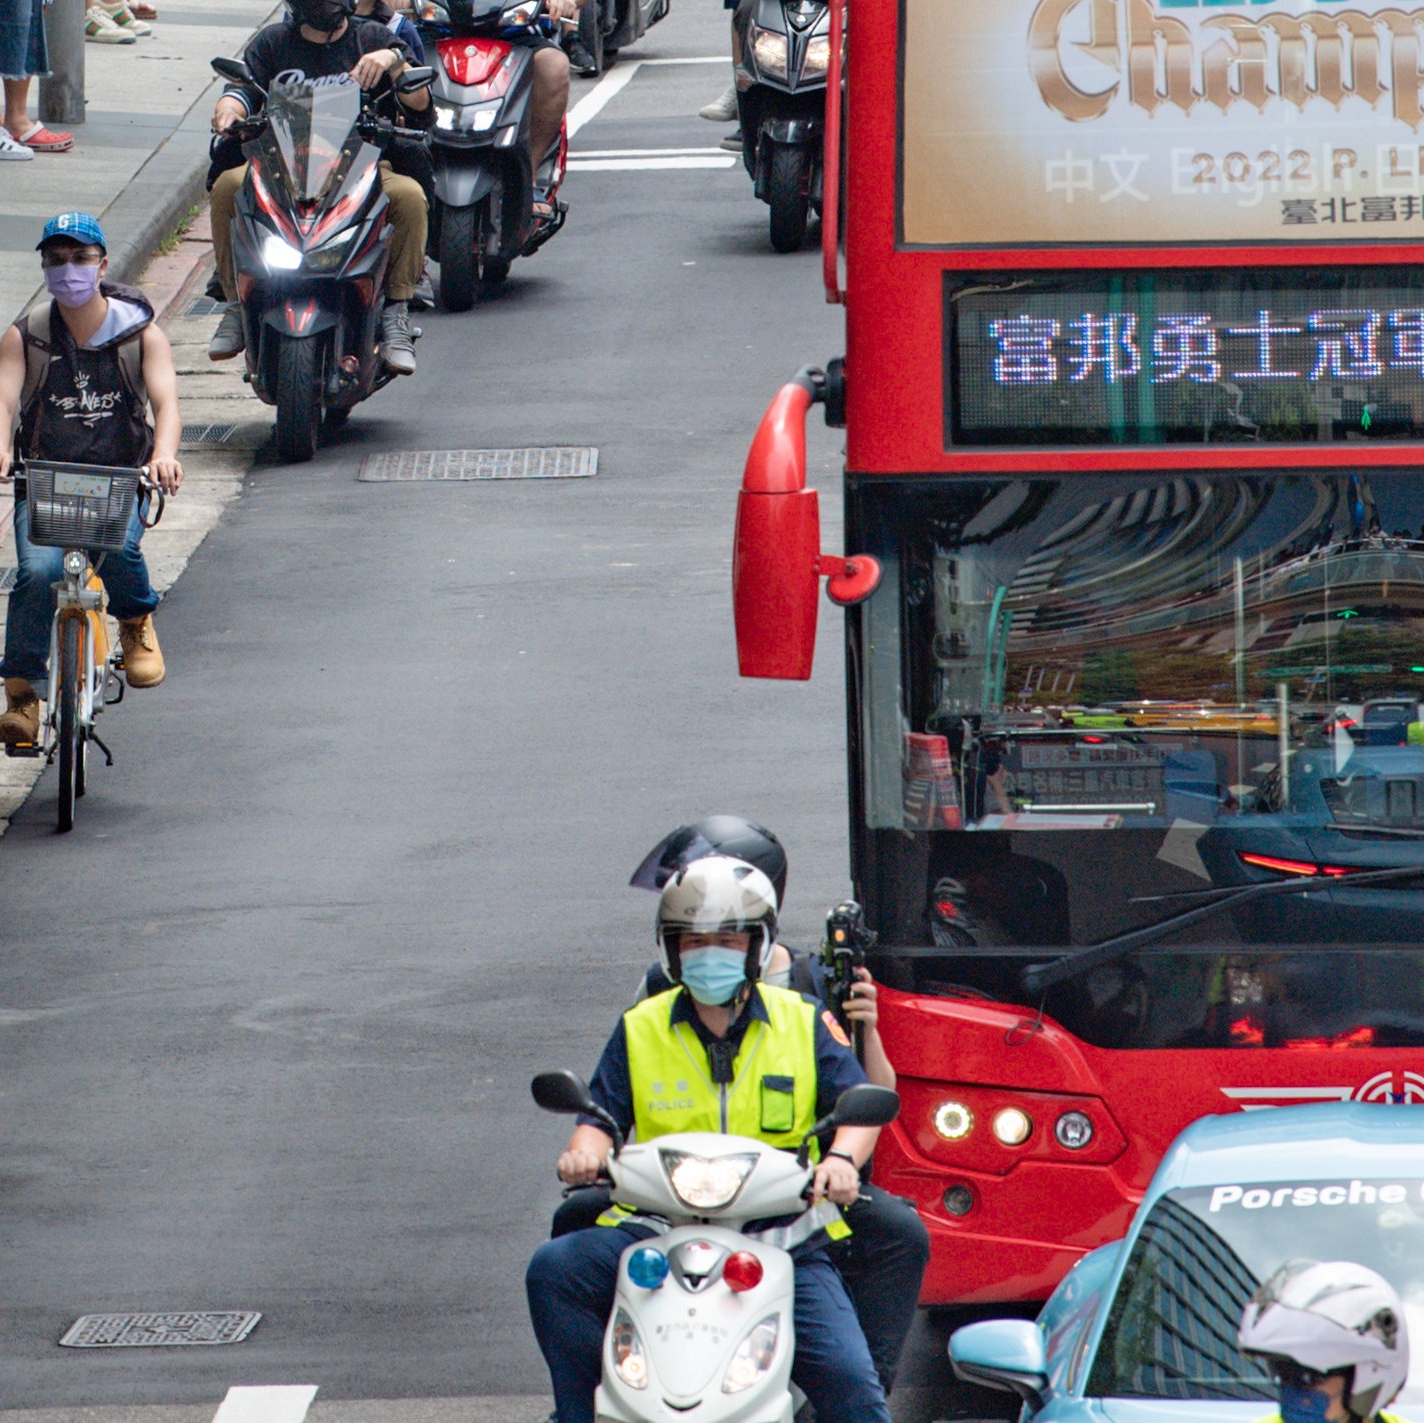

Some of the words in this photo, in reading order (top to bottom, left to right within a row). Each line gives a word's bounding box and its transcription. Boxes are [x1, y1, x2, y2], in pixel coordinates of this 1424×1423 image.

[1191, 149, 1312, 184] 2022
[58, 213, 71, 230] G
[55, 389, 115, 412] BAVES
[1209, 1180, 1407, 1213] Porsche
